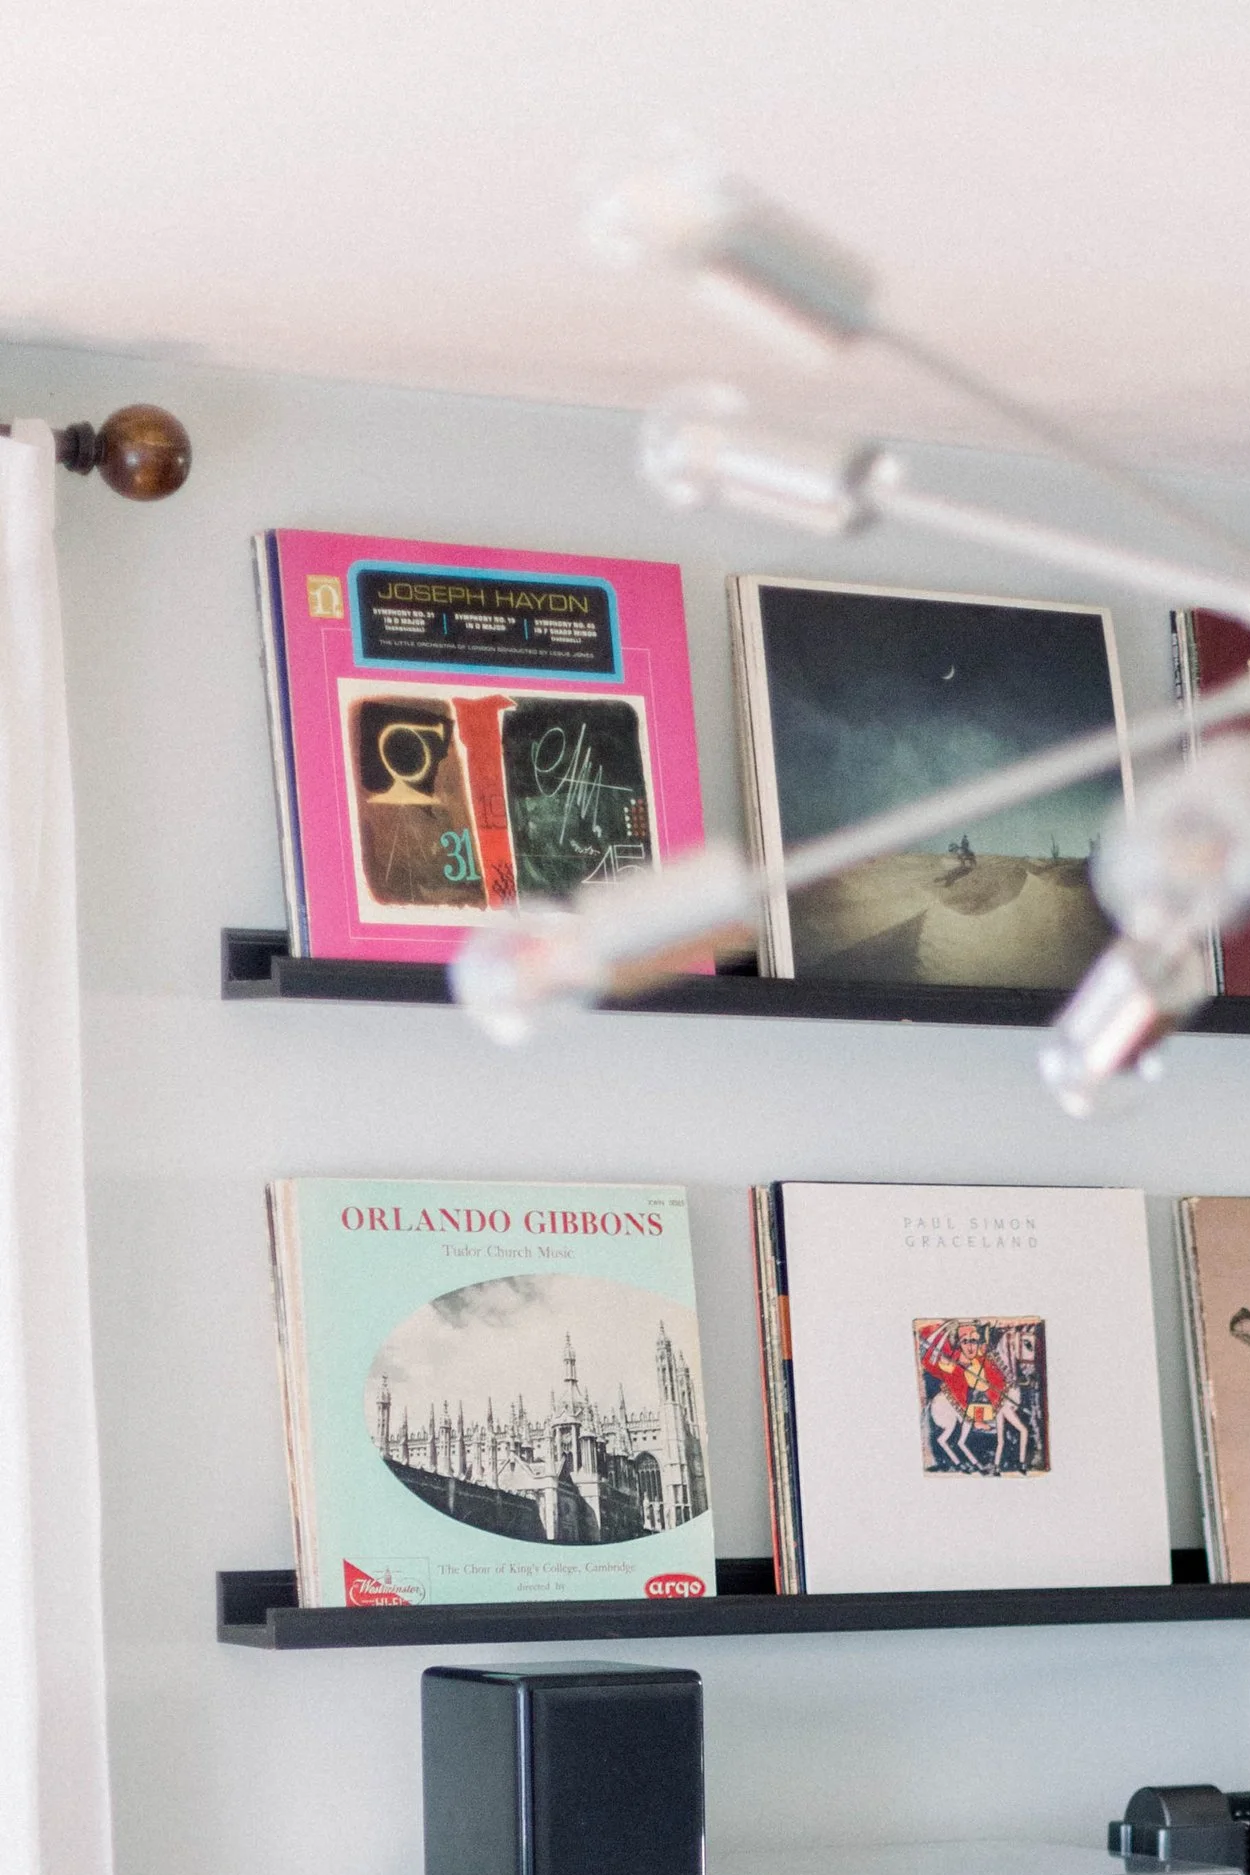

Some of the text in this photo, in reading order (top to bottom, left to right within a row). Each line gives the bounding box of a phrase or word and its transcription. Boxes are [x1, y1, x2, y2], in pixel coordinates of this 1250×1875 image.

[378, 583, 588, 613] JOSEPH HAYDN
[373, 608, 411, 617] SYMPHONY
[412, 610, 425, 618] NO.
[454, 613, 492, 622] SYMPHONY
[401, 618, 426, 627] MAJOR
[534, 619, 572, 628] SYMPHONY
[440, 828, 481, 881] 31
[341, 1206, 664, 1236] ORLANDO GIBBONS
[903, 1216, 1036, 1230] PAUL SIMON
[904, 1235, 1038, 1249] GRACELAND
[442, 1243, 481, 1259] Tudor
[487, 1244, 533, 1259] Church
[438, 1563, 460, 1575] The
[464, 1563, 490, 1575] Choir
[496, 1563, 505, 1575] of
[509, 1563, 539, 1577] King's
[585, 1562, 637, 1575] Cambridge
[517, 1582, 566, 1593] directed by
[650, 1580, 702, 1598] argo
